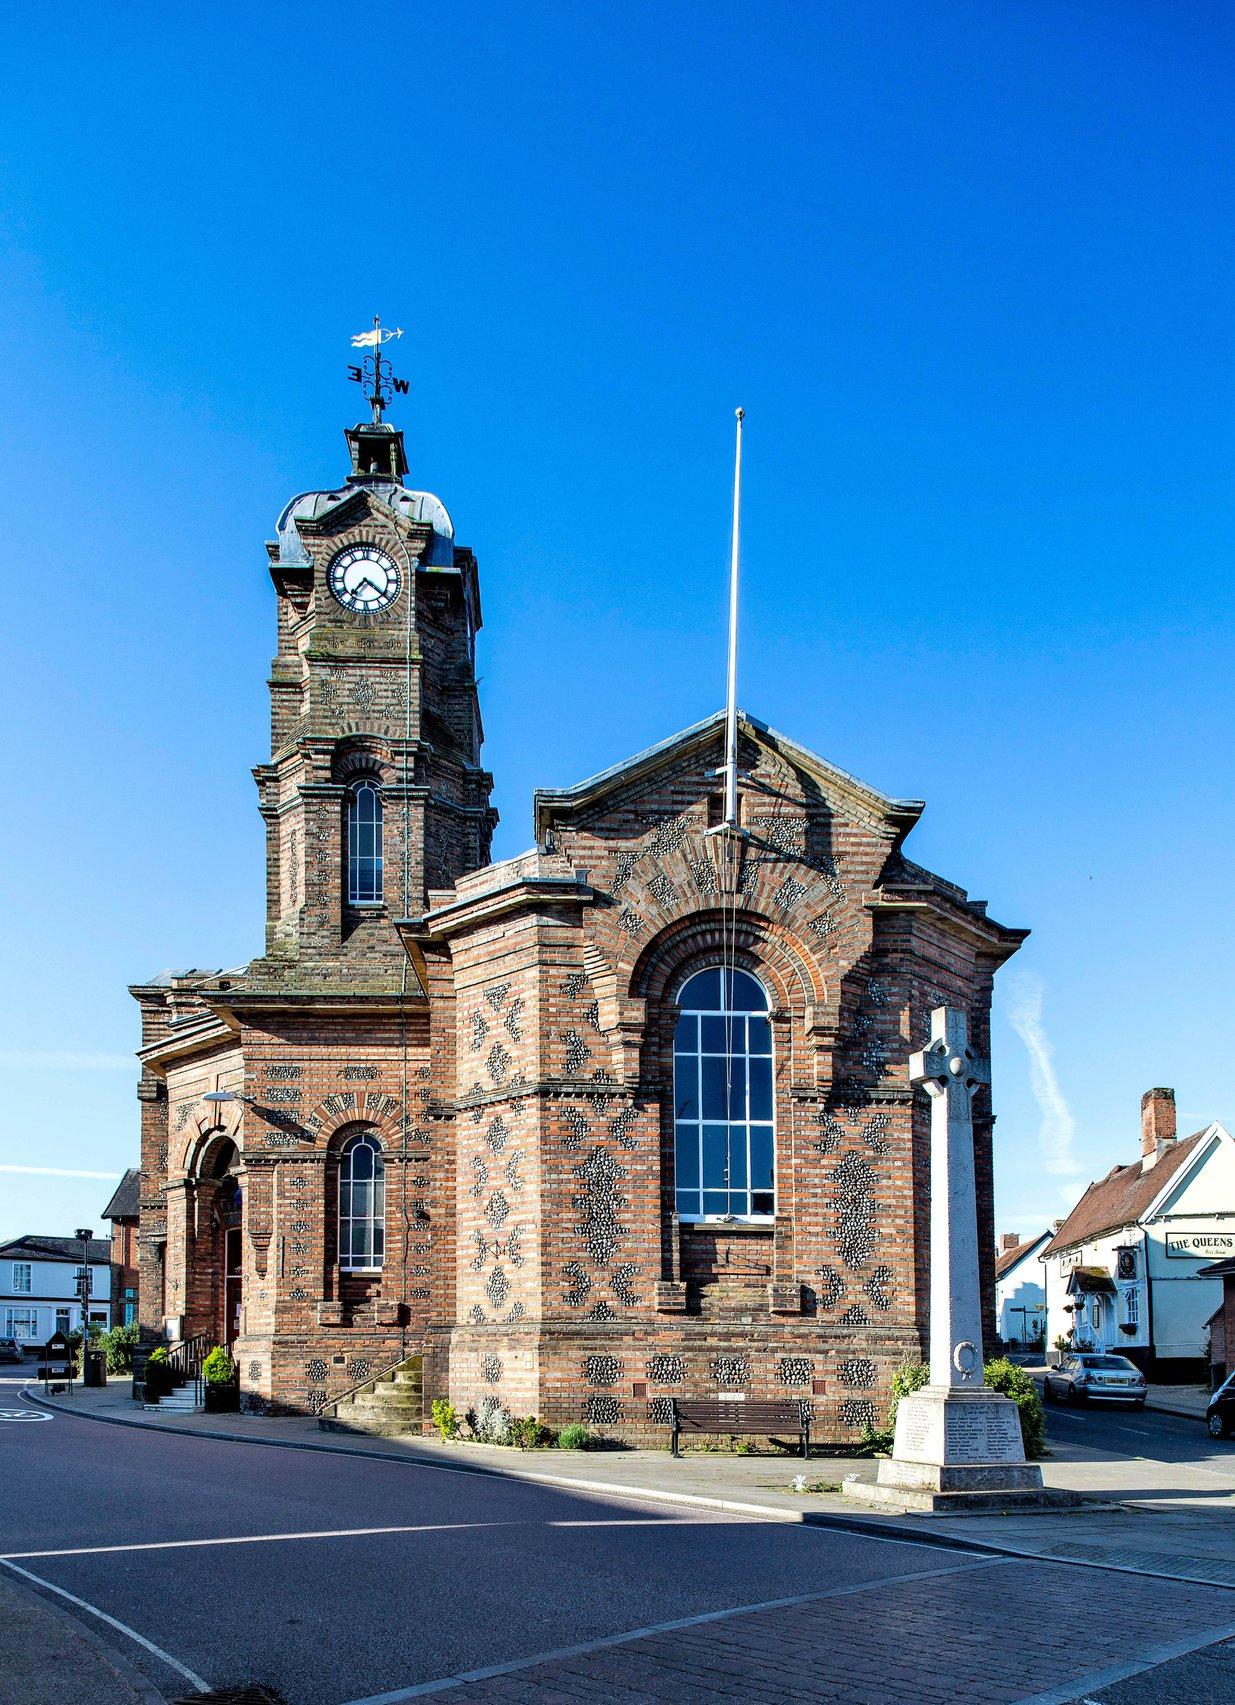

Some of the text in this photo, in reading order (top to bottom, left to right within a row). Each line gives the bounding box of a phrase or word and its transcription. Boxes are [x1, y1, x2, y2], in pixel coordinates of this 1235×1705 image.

[392, 377, 410, 395] W
[1168, 1237, 1233, 1251] THE QUEENS
